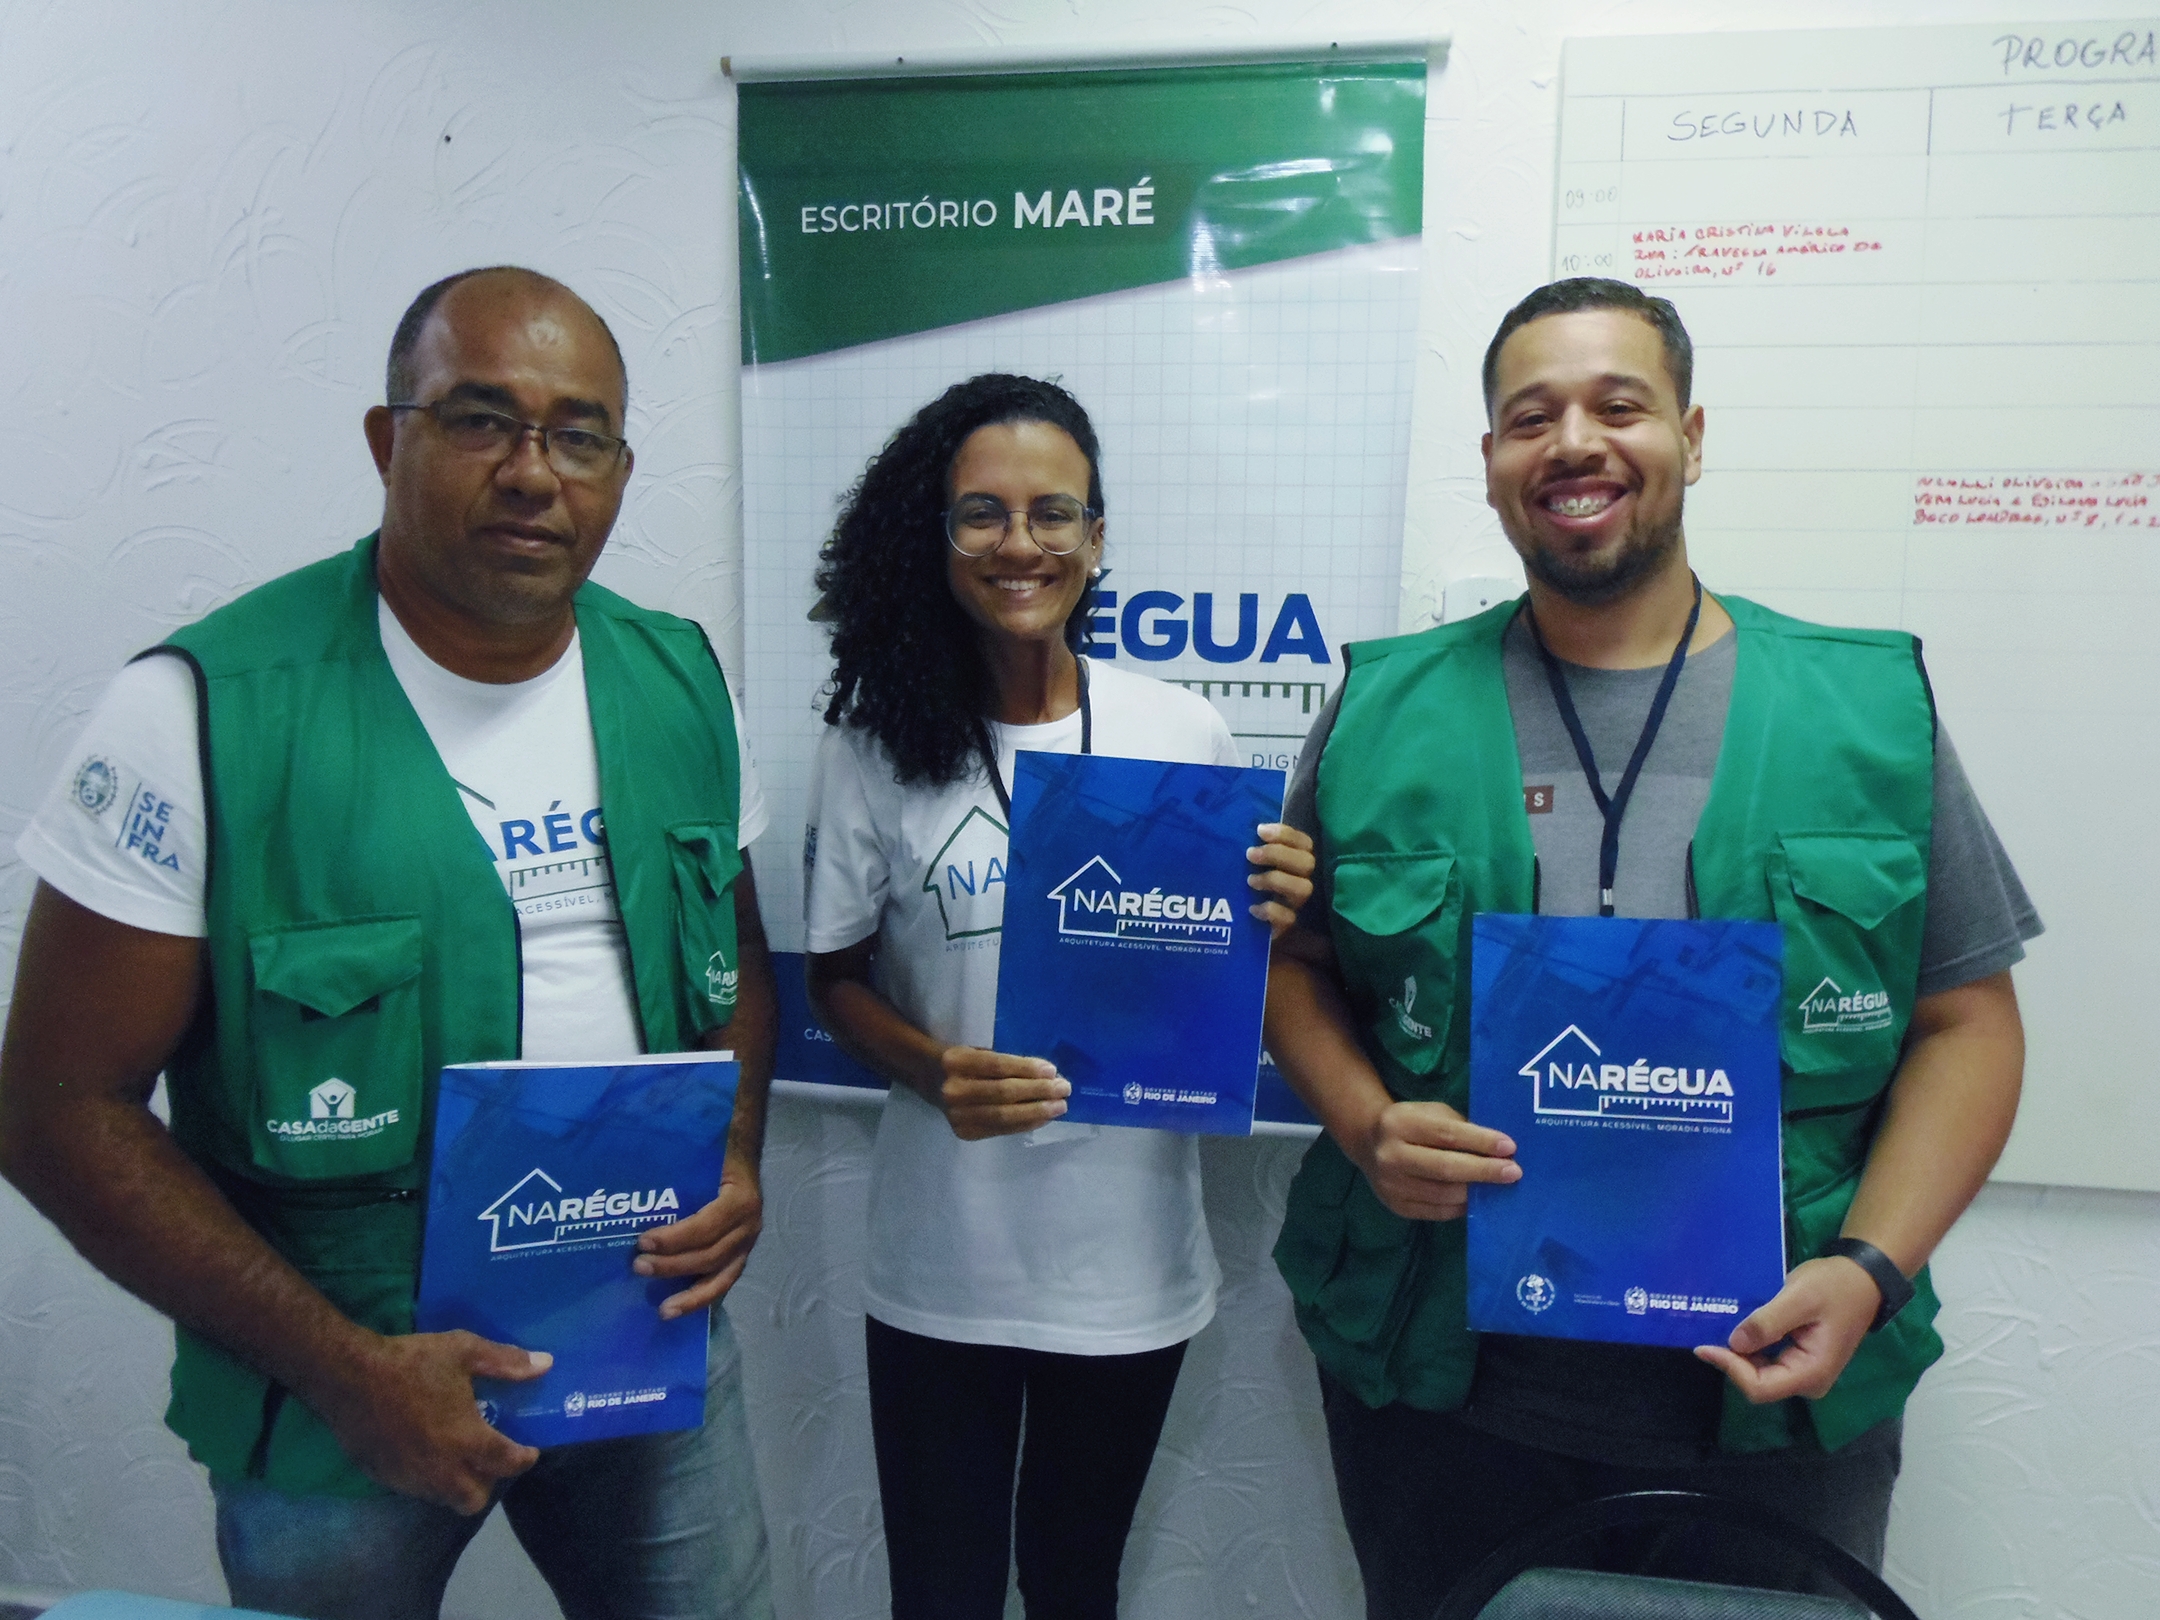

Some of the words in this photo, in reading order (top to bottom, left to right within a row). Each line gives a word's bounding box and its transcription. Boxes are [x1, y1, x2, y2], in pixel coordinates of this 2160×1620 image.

[1992, 30, 2156, 76] PROGRA
[1667, 109, 1858, 142] SEGUNDA
[1998, 101, 2126, 137] TERÇA
[801, 195, 998, 234] ESCRITÓRIO
[1014, 177, 1155, 229] MARÉ
[1757, 261, 1777, 276] 16
[139, 791, 174, 823] SE
[131, 813, 165, 842] IN
[126, 834, 180, 871] FRA
[946, 856, 1006, 900] NA
[1073, 887, 1233, 922] NARÉGUA
[1059, 937, 1115, 947] ARQUITETURA
[804, 1027, 834, 1042] CAS
[1549, 1058, 1734, 1096] NARÉGUA
[1143, 1091, 1161, 1101] RIO
[1162, 1093, 1175, 1102] DE
[1176, 1094, 1217, 1105] JANEIRO
[1535, 1118, 1599, 1128] ARQUITETURA
[1657, 1124, 1700, 1133] MORADIA
[508, 1188, 680, 1227] NARÉGUA
[1650, 1299, 1671, 1309] RIO
[1672, 1300, 1688, 1311] DE
[1689, 1302, 1738, 1315] JANEIRO
[587, 1398, 607, 1409] RIO
[608, 1397, 622, 1406] DE
[623, 1392, 667, 1405] JANEIRO
